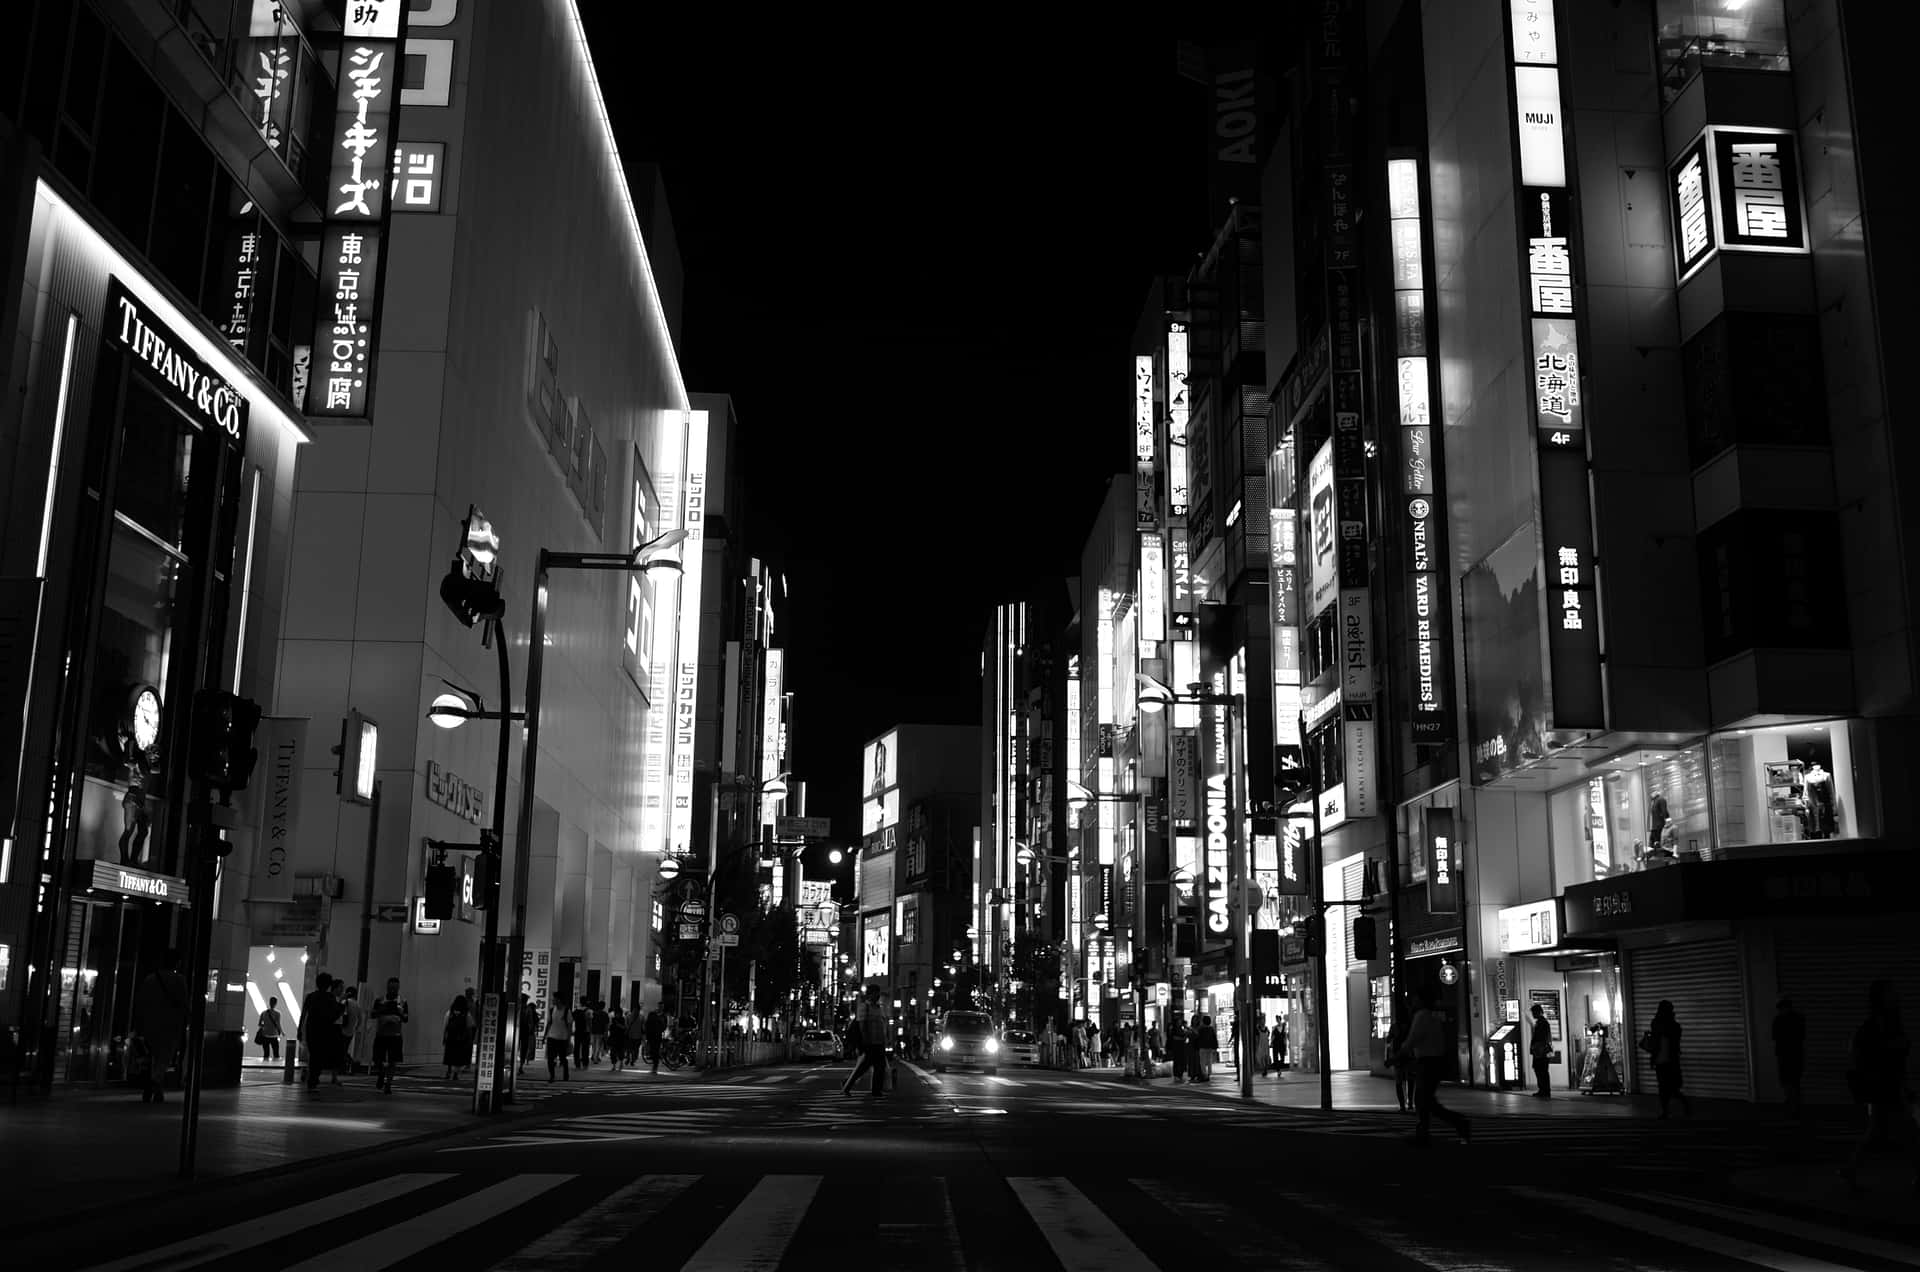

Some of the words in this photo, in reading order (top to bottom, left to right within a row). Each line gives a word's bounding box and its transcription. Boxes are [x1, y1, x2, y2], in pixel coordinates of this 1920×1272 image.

[1525, 0, 1541, 41] みや
[334, 47, 384, 215] シェーキーズ
[1525, 112, 1554, 125] MUJI
[1678, 152, 1709, 264] 番屋
[1731, 143, 1788, 239] 番屋
[1529, 237, 1573, 313] 番屋
[1538, 355, 1569, 417] 北海道
[1551, 431, 1571, 445] 4F
[1174, 555, 1188, 599] ガスト
[1413, 521, 1427, 570] NEAL'S
[1416, 576, 1428, 616] YARD
[1558, 546, 1583, 630] 無印良品
[1418, 620, 1433, 701] REMEDIES
[678, 663, 695, 744] ビックカメラ
[1207, 774, 1229, 933] CALZEDONIA
